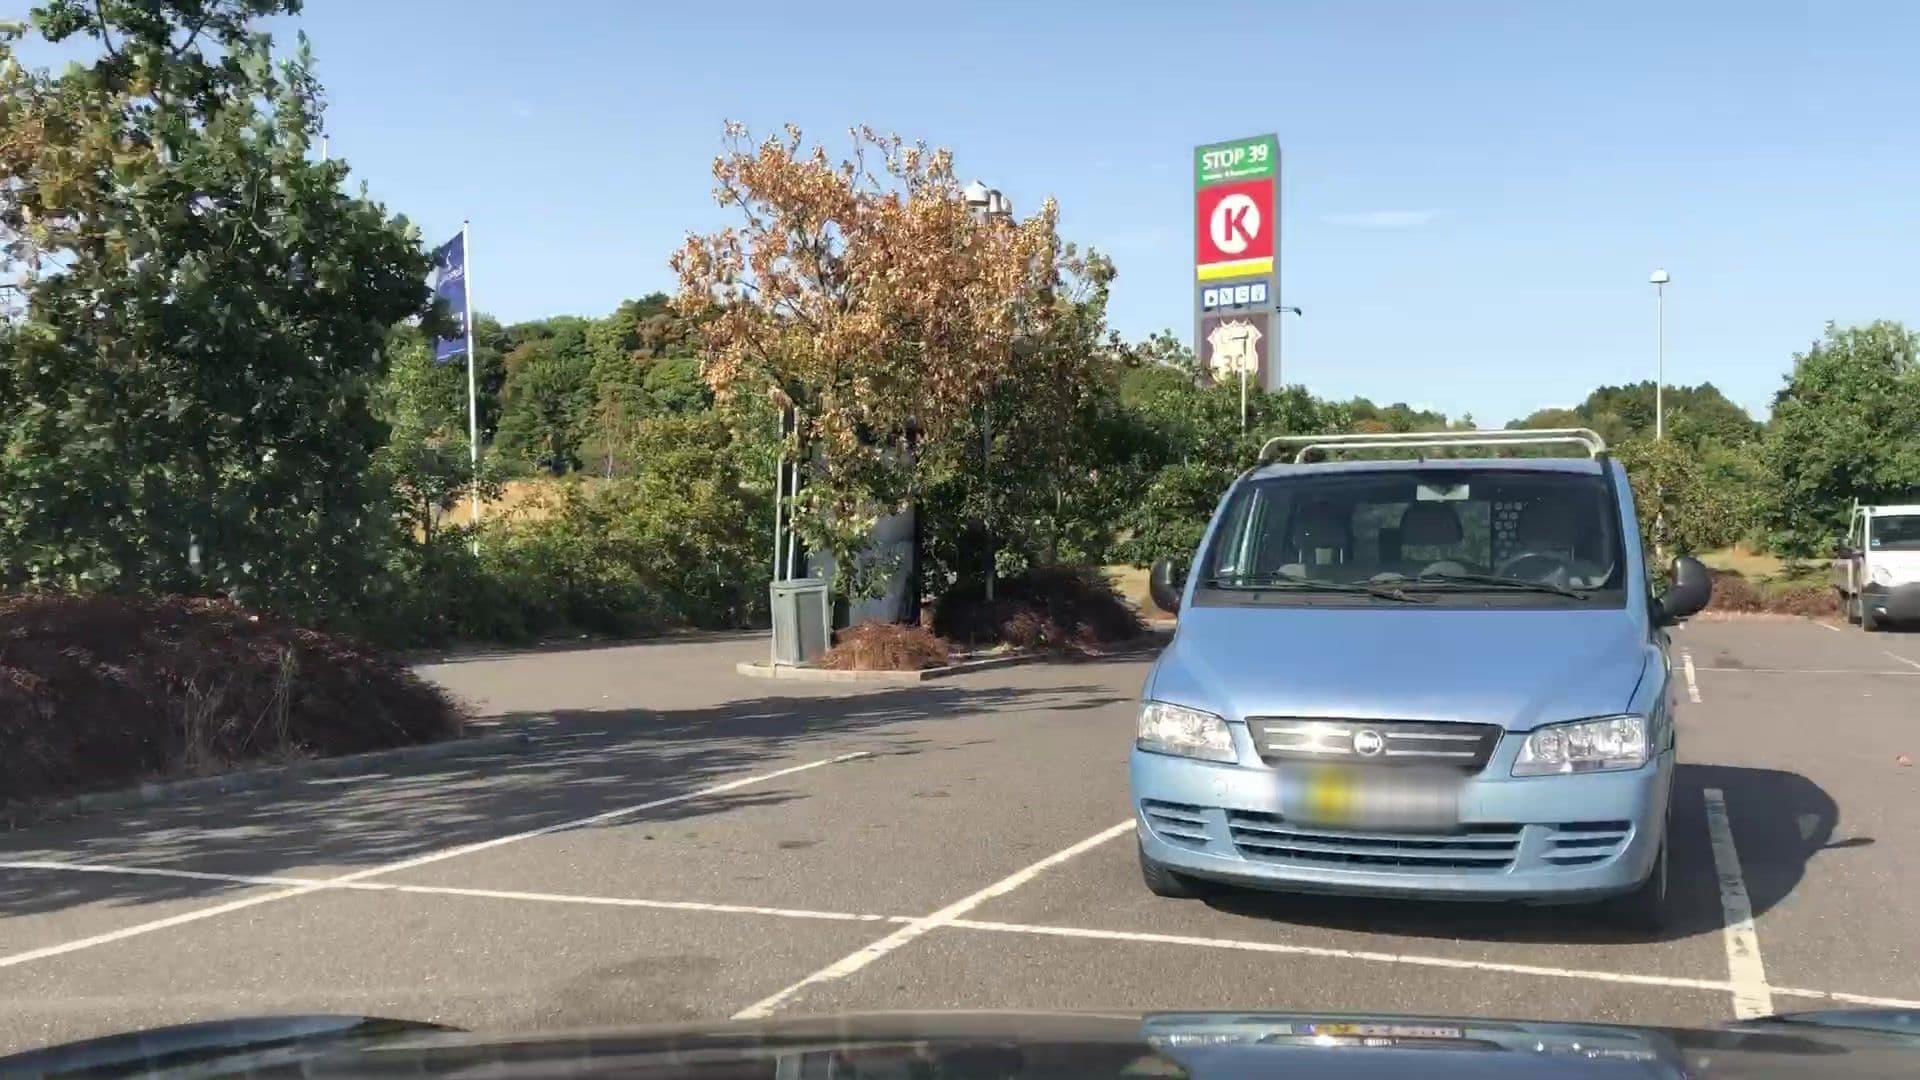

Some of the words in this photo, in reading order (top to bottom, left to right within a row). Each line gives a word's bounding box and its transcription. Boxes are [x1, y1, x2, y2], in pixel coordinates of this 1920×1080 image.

[1203, 148, 1245, 170] STOP
[1248, 144, 1268, 163] 39
[1224, 204, 1253, 243] K
